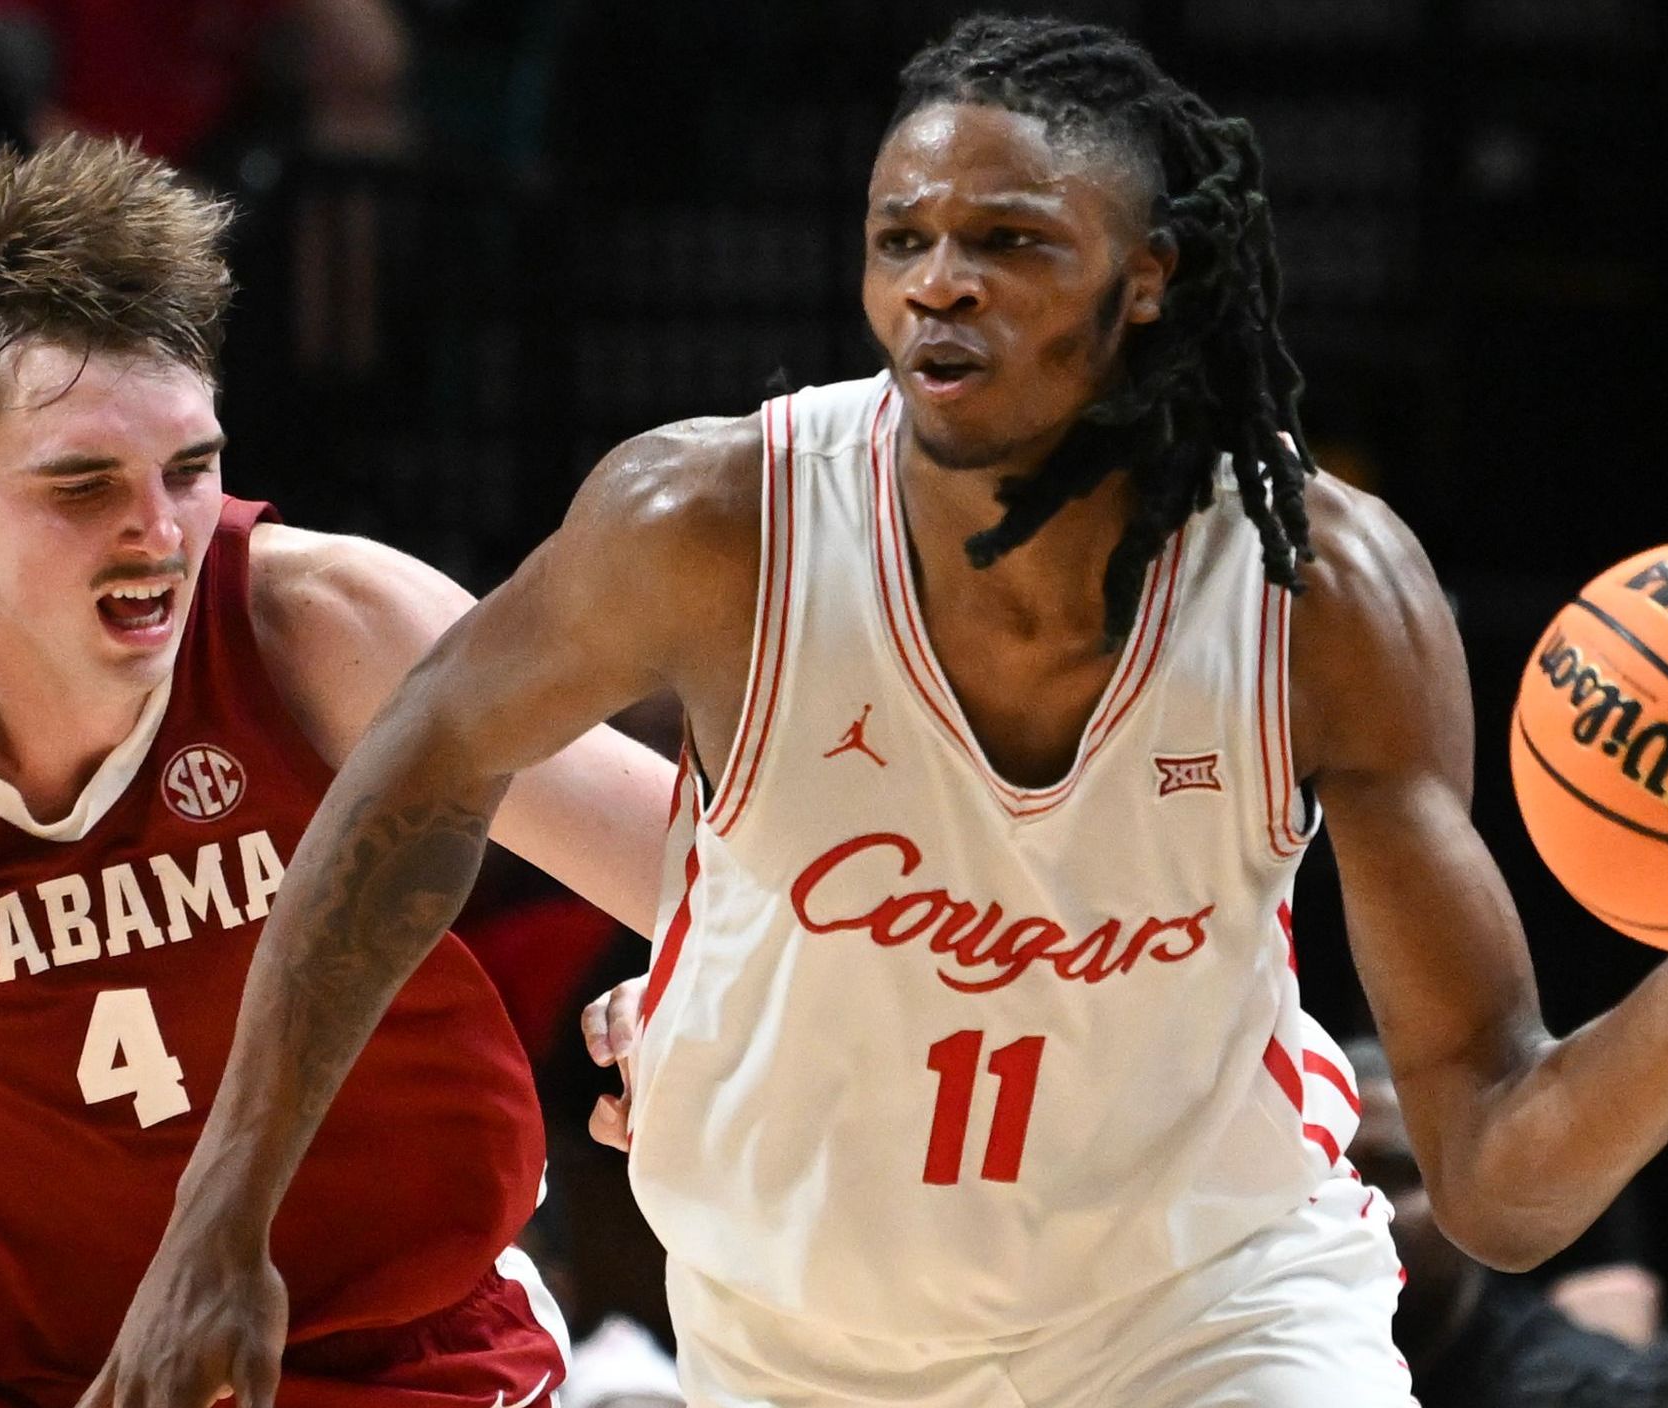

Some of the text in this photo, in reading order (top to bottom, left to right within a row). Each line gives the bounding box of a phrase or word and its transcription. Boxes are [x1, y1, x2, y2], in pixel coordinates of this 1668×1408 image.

[167, 749, 241, 817] SEC
[790, 832, 1216, 993] Cougars
[76, 987, 192, 1129] 4
[922, 1029, 1046, 1185] 11
